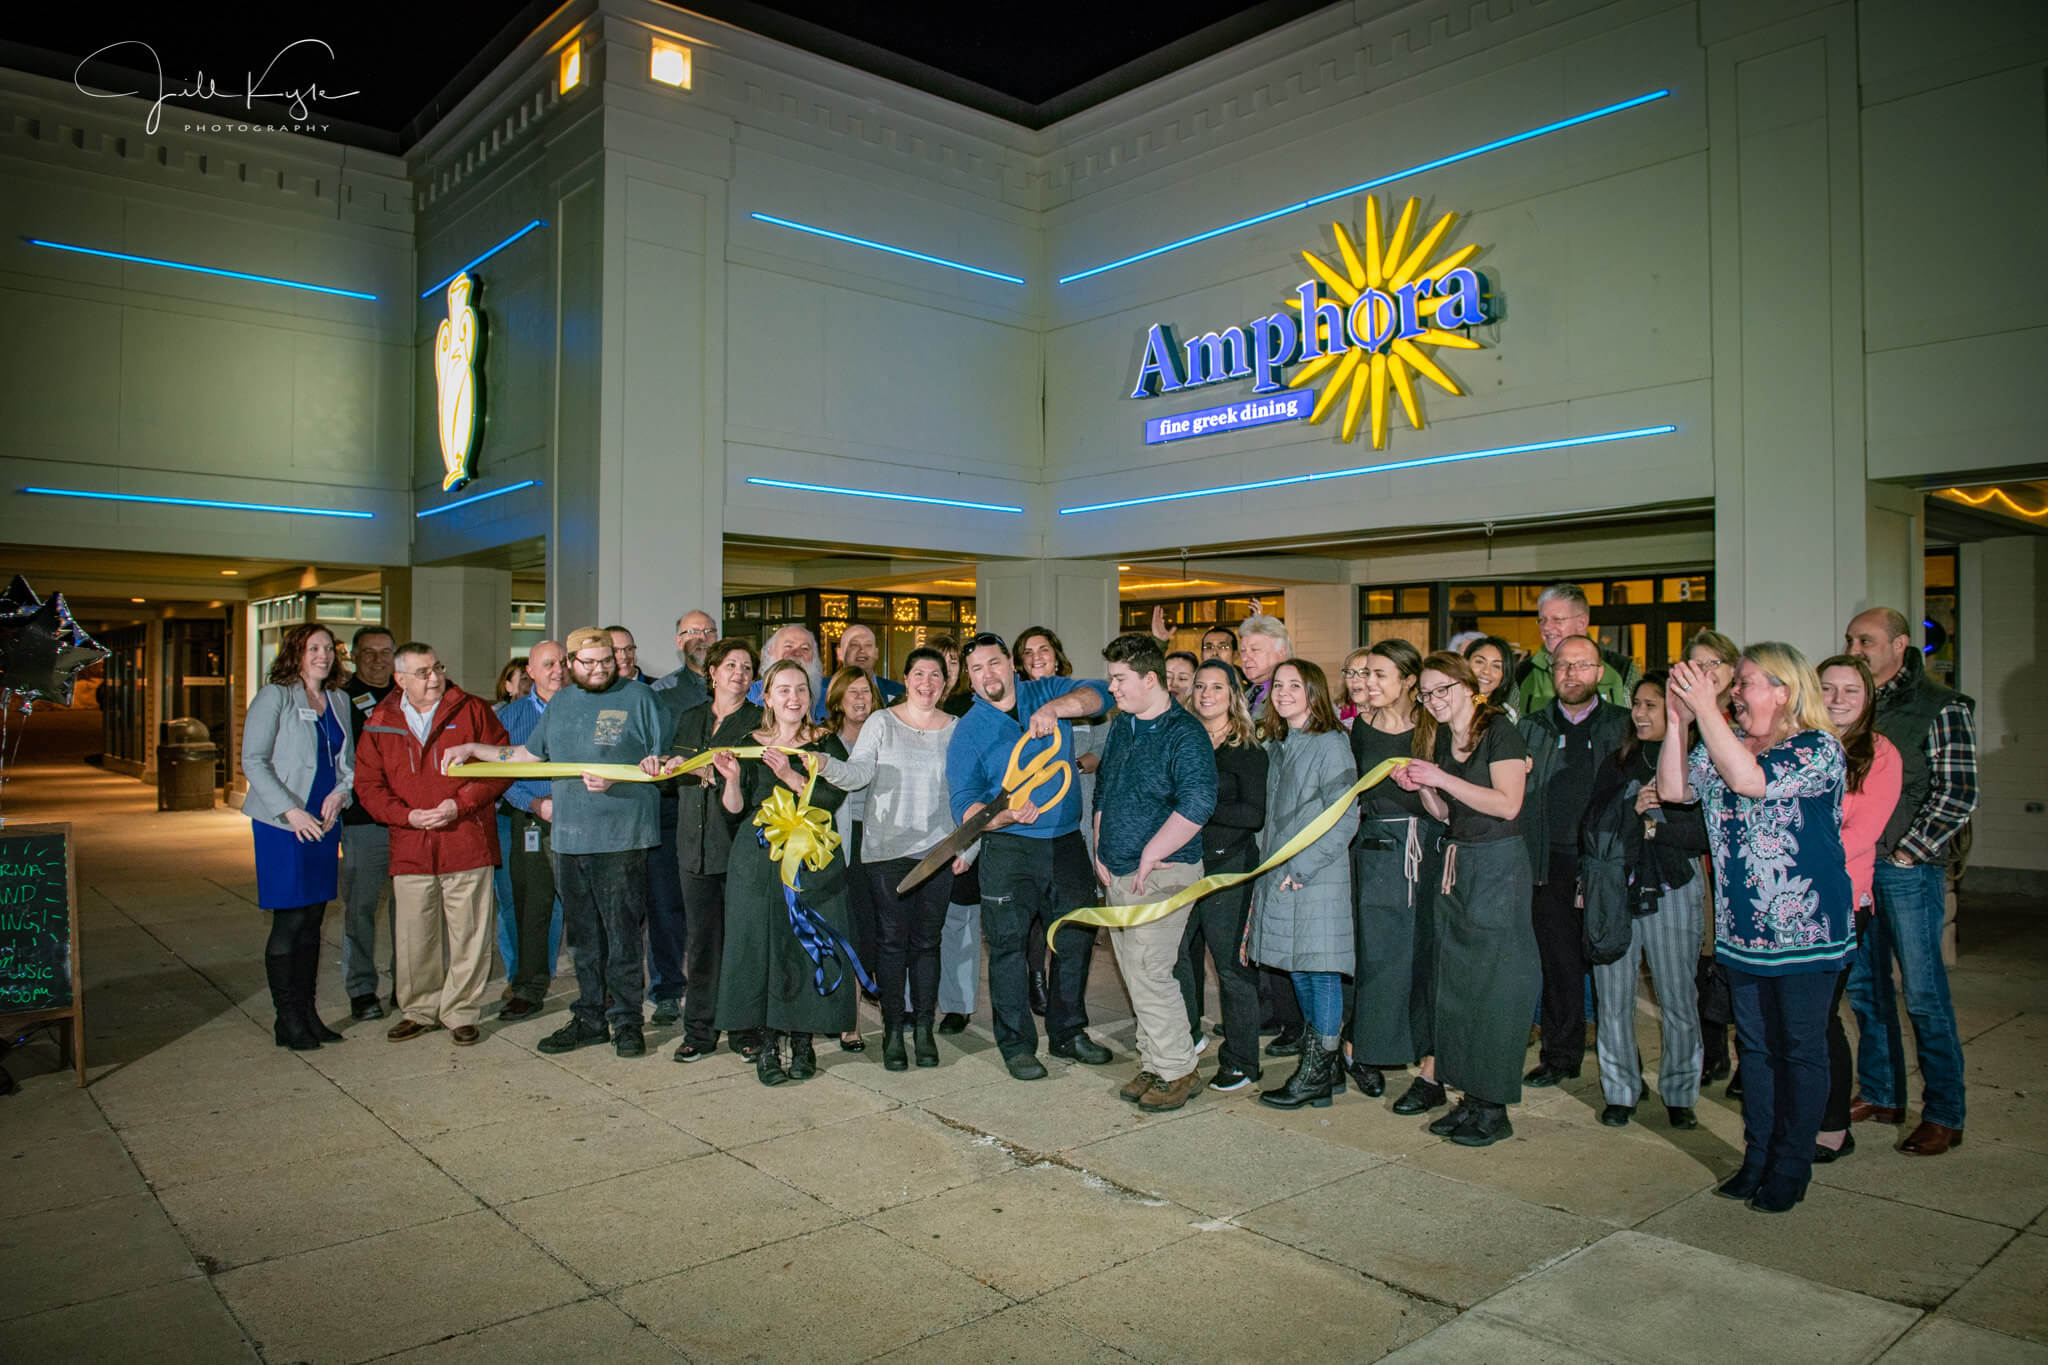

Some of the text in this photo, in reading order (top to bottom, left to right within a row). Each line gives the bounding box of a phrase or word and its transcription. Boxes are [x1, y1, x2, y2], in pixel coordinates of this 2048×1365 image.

[1131, 266, 1488, 399] Amphora
[1159, 397, 1298, 436] fine greek dining
[1678, 580, 1690, 600] 3
